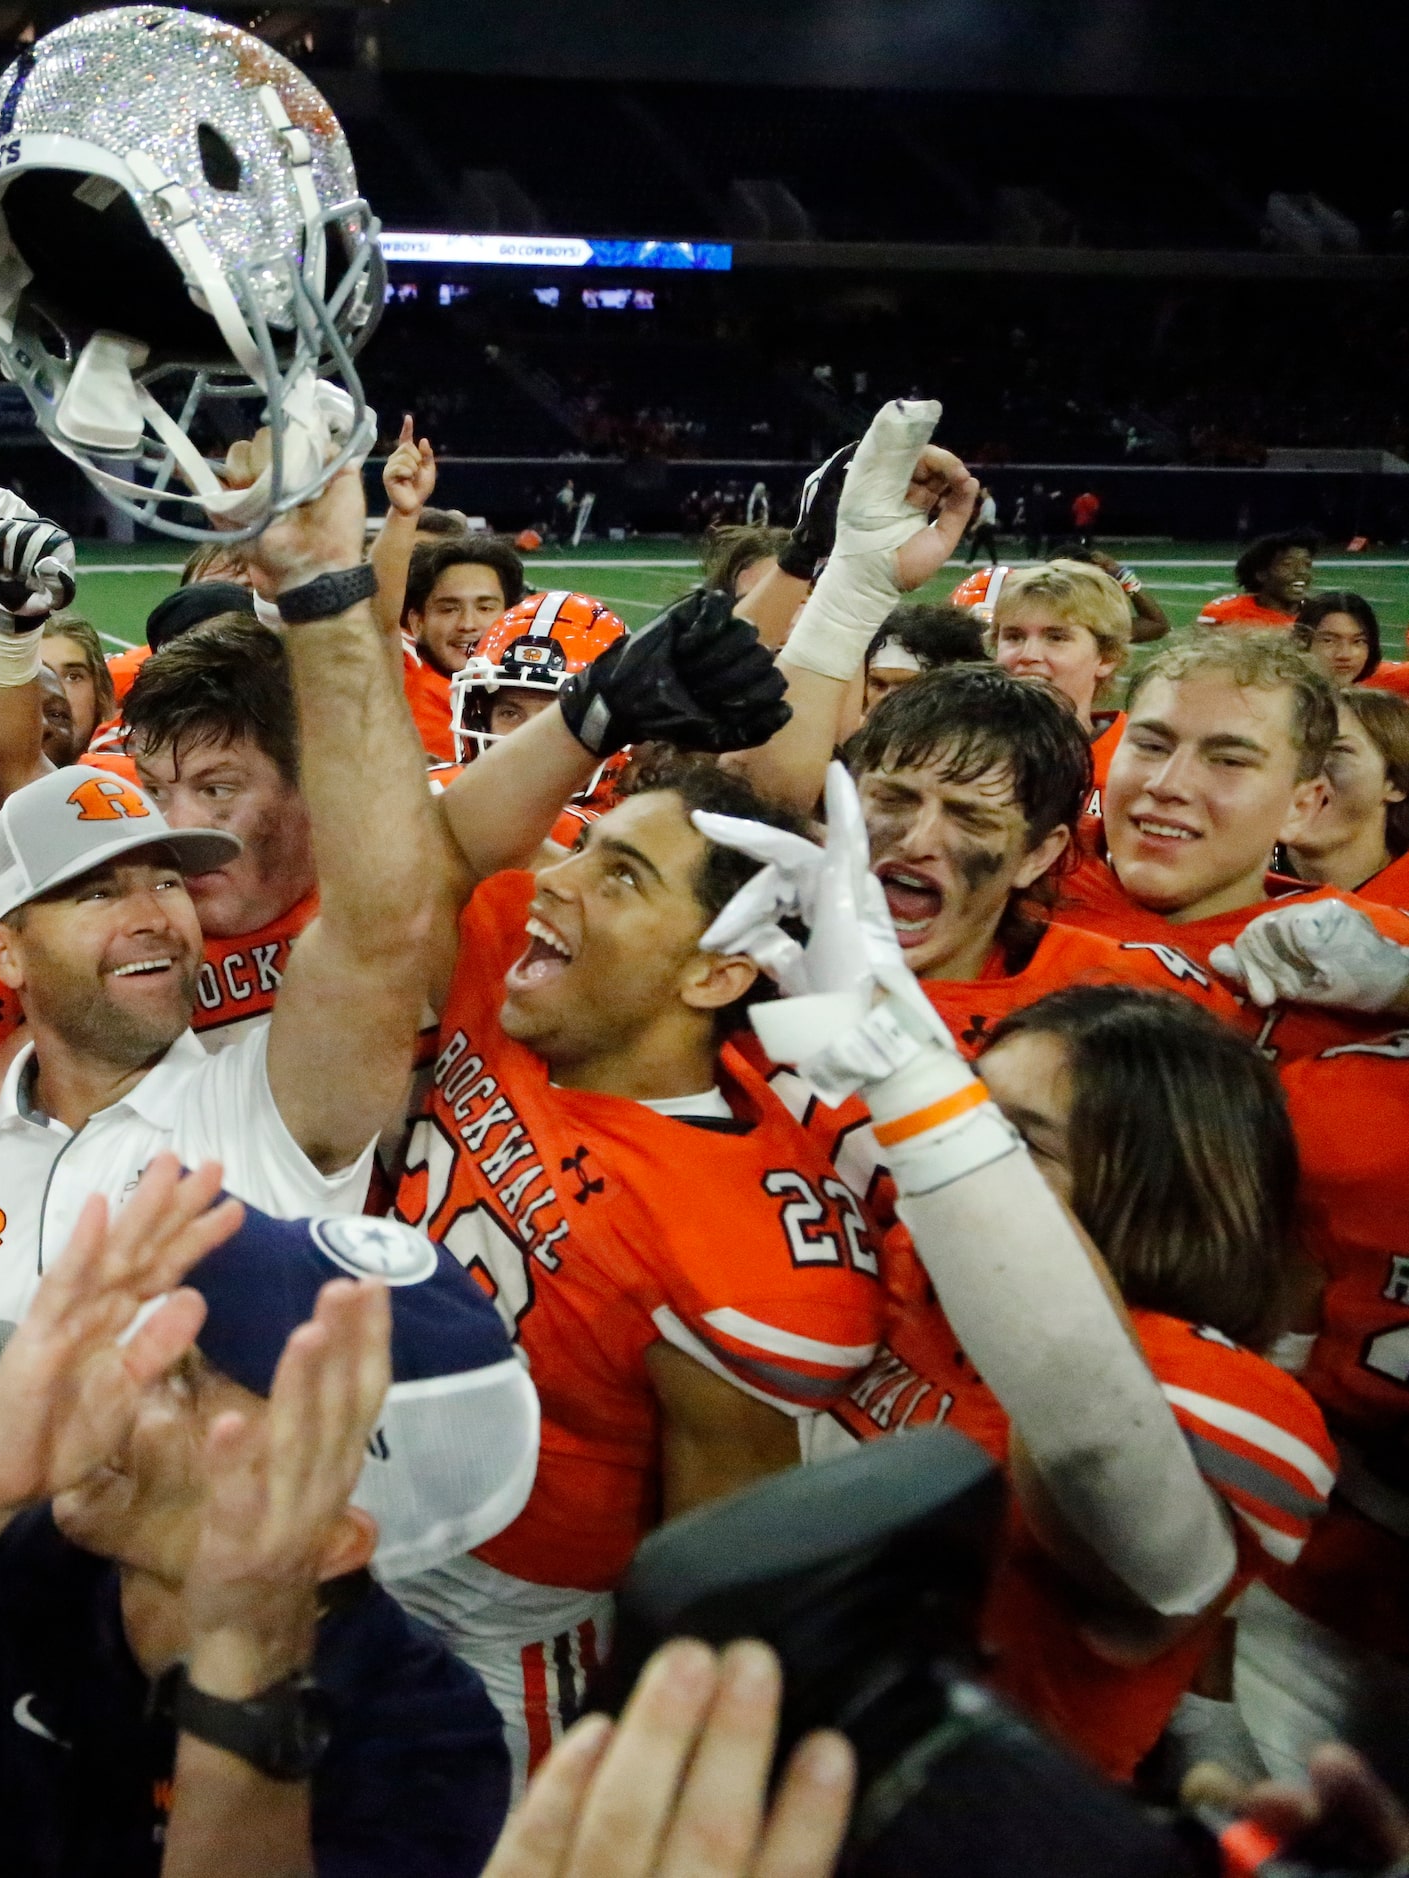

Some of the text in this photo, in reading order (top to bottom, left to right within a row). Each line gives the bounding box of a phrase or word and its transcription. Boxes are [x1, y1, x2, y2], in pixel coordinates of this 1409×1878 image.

[65, 777, 150, 821] R
[197, 938, 298, 1009] OCK
[435, 1030, 570, 1273] ROCKWALL
[762, 1168, 880, 1278] 22
